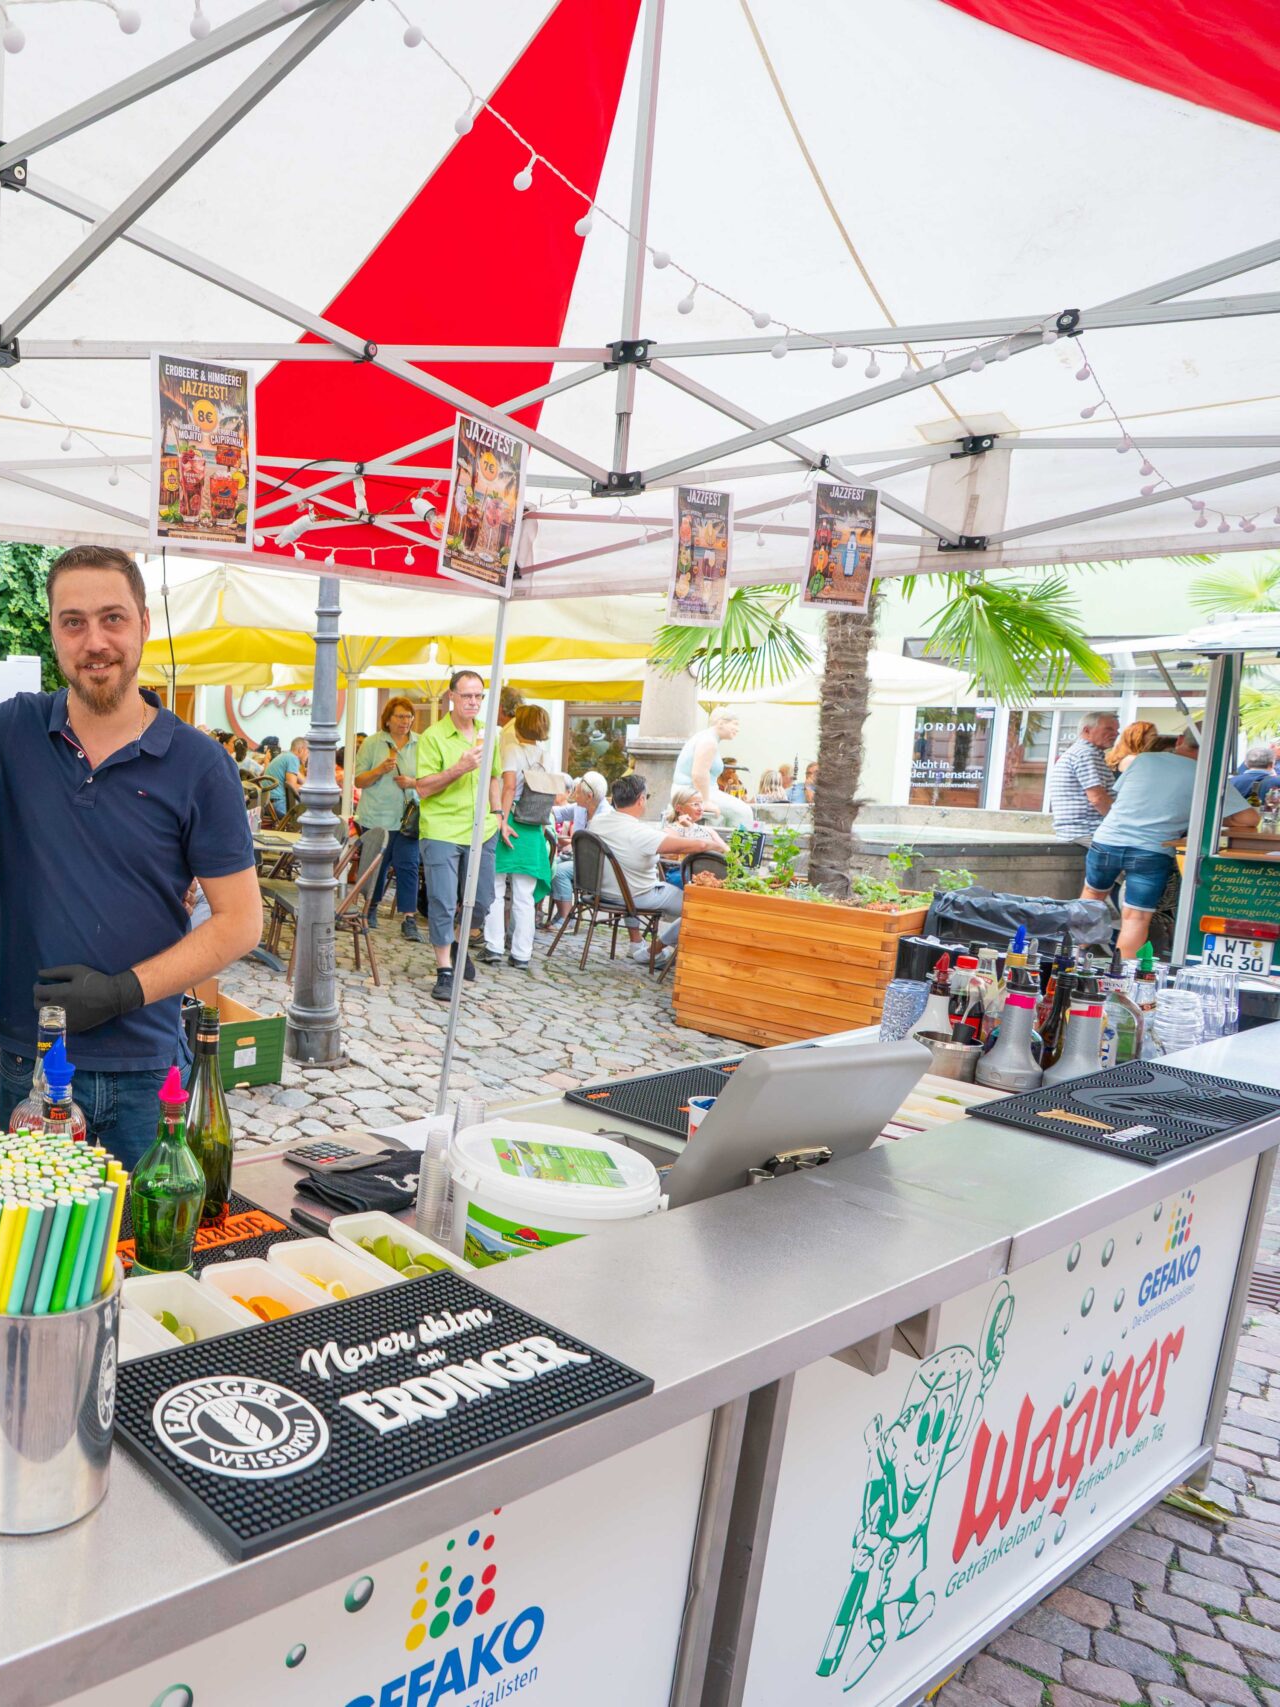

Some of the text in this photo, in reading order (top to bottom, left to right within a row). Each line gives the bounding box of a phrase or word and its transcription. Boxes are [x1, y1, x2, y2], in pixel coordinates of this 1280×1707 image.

[165, 363, 242, 388] ERDBEERE & HIMBEERE!
[179, 380, 229, 401] JAZZFEST!
[197, 410, 213, 424] 8€
[178, 430, 202, 442] MOJITO
[465, 421, 517, 457] JAZZFEST
[483, 460, 495, 475] 7€
[686, 489, 722, 506] JAZZFEST
[829, 486, 866, 501] JAZZFEST
[913, 722, 977, 732] JORDAN
[912, 759, 938, 769] Nicht
[1214, 863, 1239, 874] Wein
[1242, 867, 1264, 875] und
[1212, 874, 1280, 887] Familie Geo
[1210, 884, 1258, 896] D-79801
[1209, 894, 1249, 906] Telefon
[1225, 939, 1252, 956] WT
[1207, 953, 1264, 973] NG 30
[1137, 1244, 1201, 1308] GEFAKO
[300, 1307, 494, 1381] Never skim
[338, 1335, 592, 1437] ERDINGER
[163, 1380, 283, 1435] ERDINGER
[951, 1324, 1185, 1565] Wagner
[944, 1421, 1167, 1599] Getränkeland Erfrisch Dir den Tag
[343, 1605, 546, 1707] EFAKO
[466, 1666, 539, 1707] zialisten
